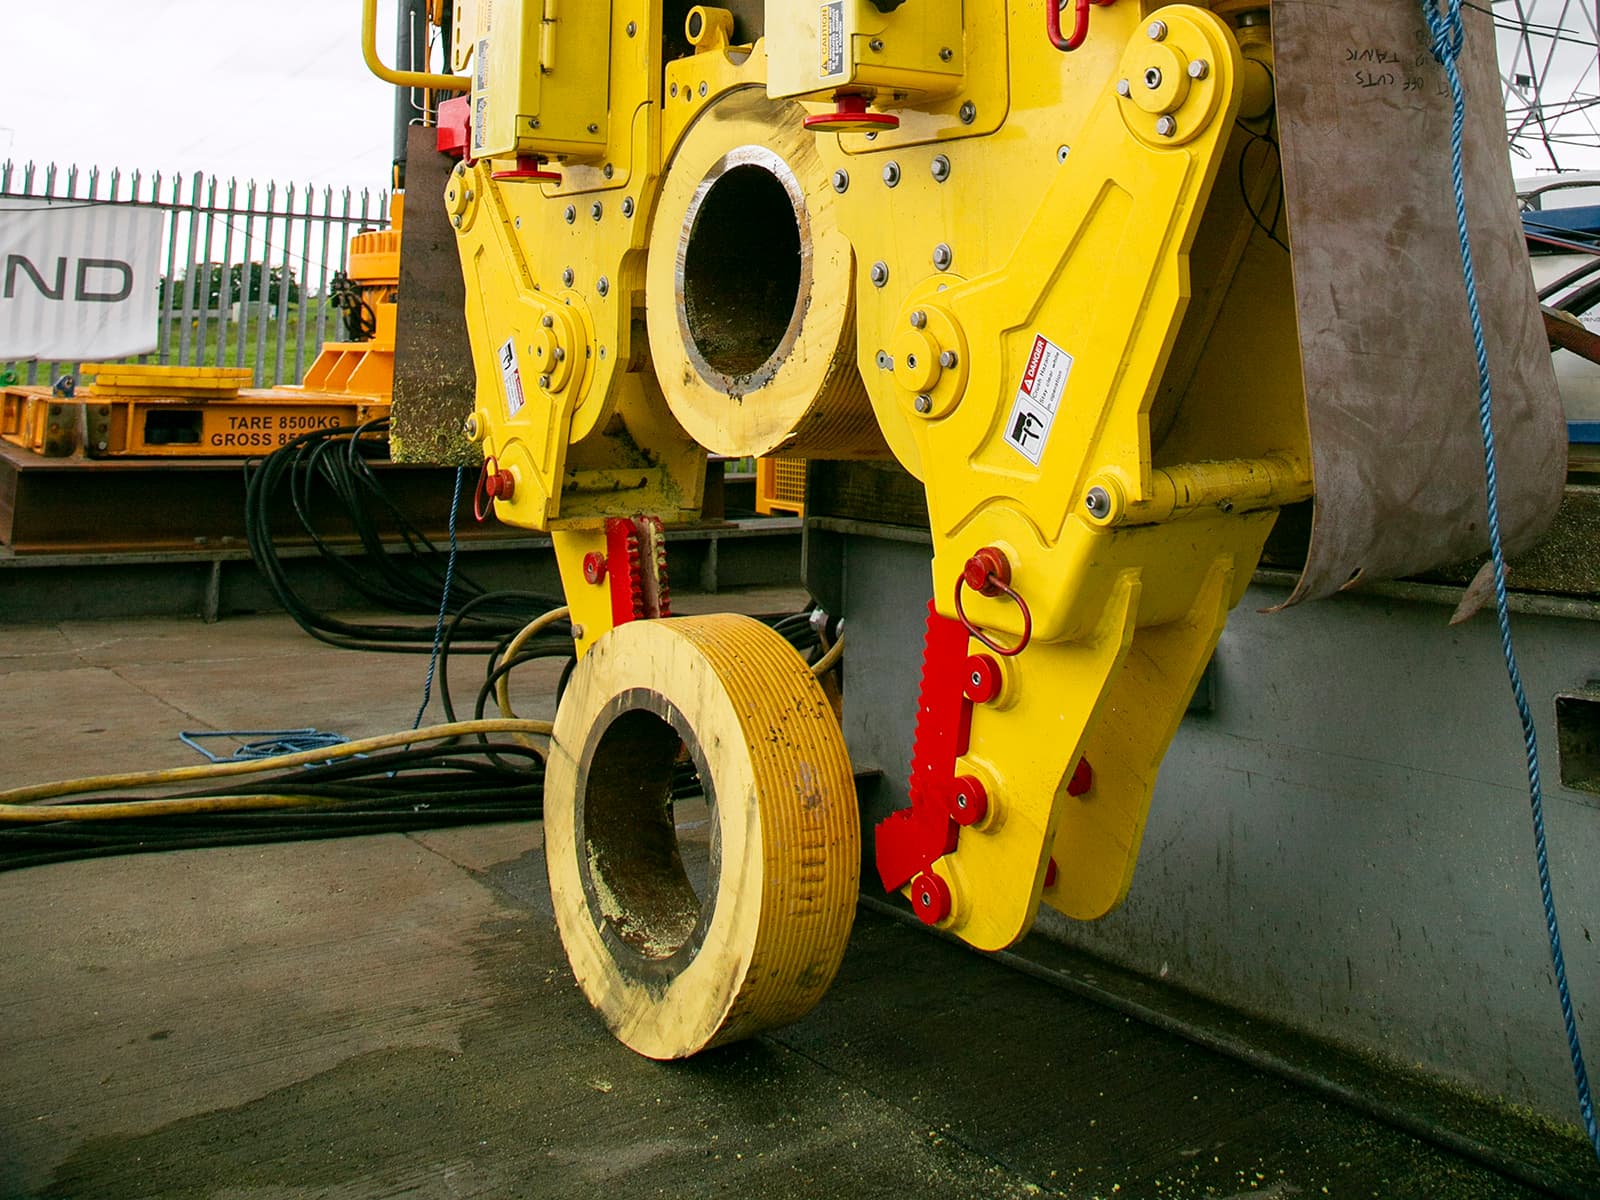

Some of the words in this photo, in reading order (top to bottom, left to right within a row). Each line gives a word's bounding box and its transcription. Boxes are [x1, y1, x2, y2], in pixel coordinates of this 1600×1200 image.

[1346, 48, 1400, 64] TANK
[1355, 71, 1394, 88] CUTS
[1403, 77, 1424, 91] OFF
[1028, 341, 1045, 377] DANGER
[1032, 378, 1042, 399] Crush
[1040, 352, 1051, 377] Hazard
[1040, 390, 1048, 404] Stay
[1052, 352, 1060, 368] while
[1050, 370, 1062, 402] operation
[229, 416, 273, 429] TARE
[279, 416, 340, 429] 8500KG
[211, 433, 272, 446] GROSS
